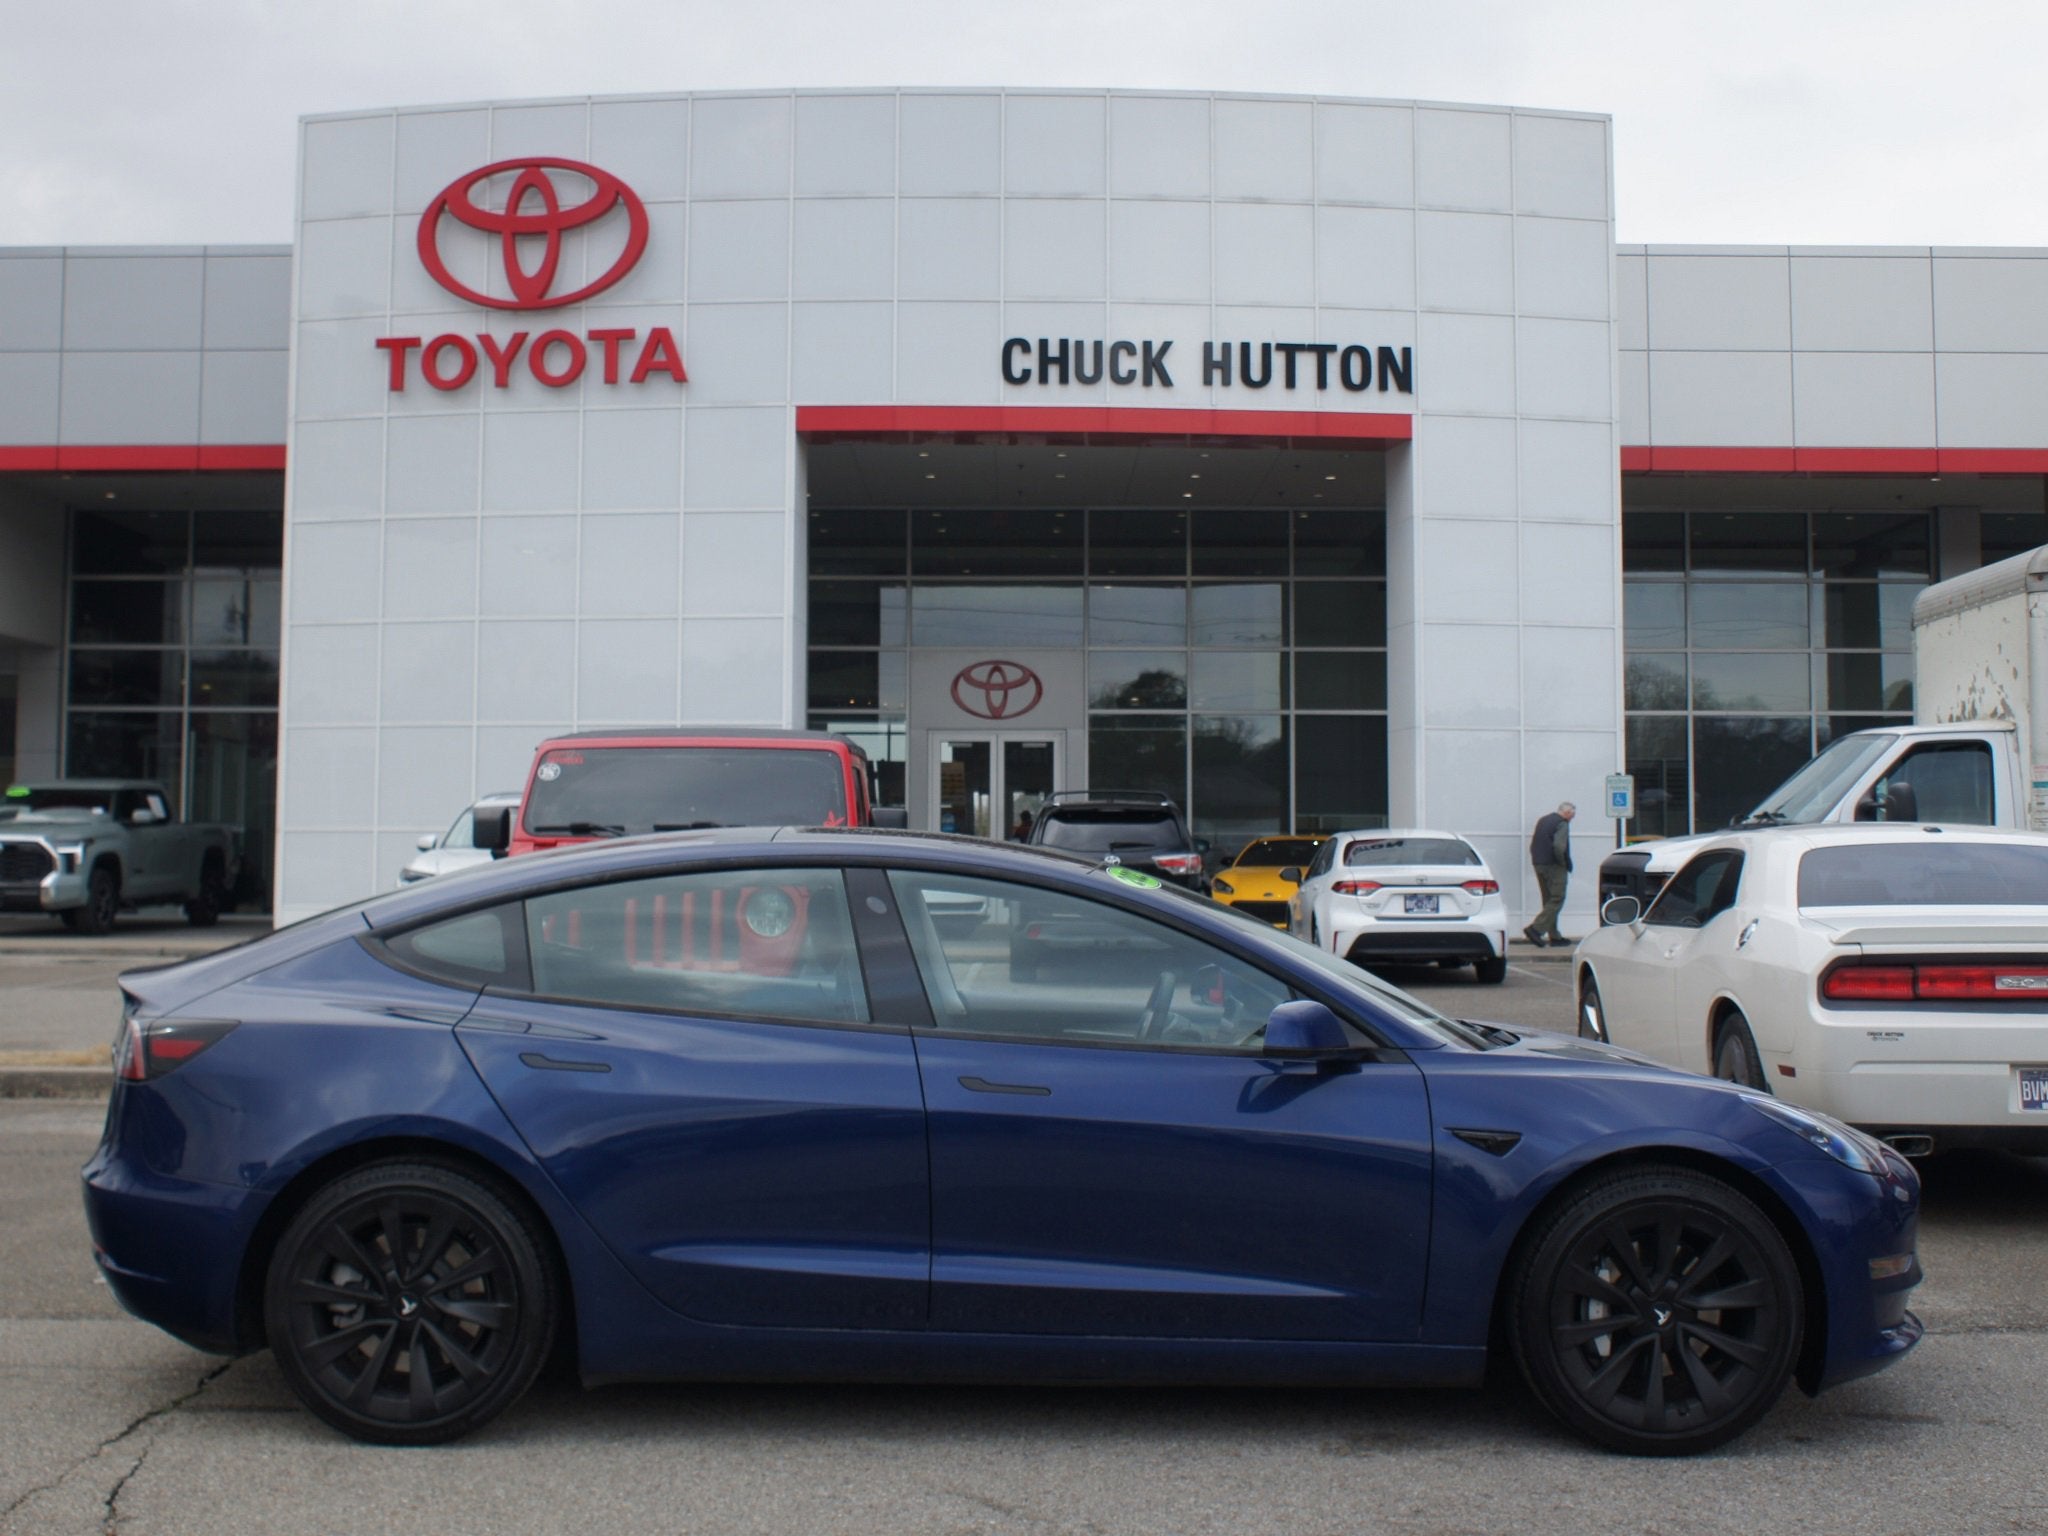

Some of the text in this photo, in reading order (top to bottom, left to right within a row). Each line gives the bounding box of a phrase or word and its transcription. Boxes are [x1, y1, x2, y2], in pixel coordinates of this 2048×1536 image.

[376, 327, 689, 392] TOYOTA
[1002, 337, 1413, 394] CHUCK HUTTON
